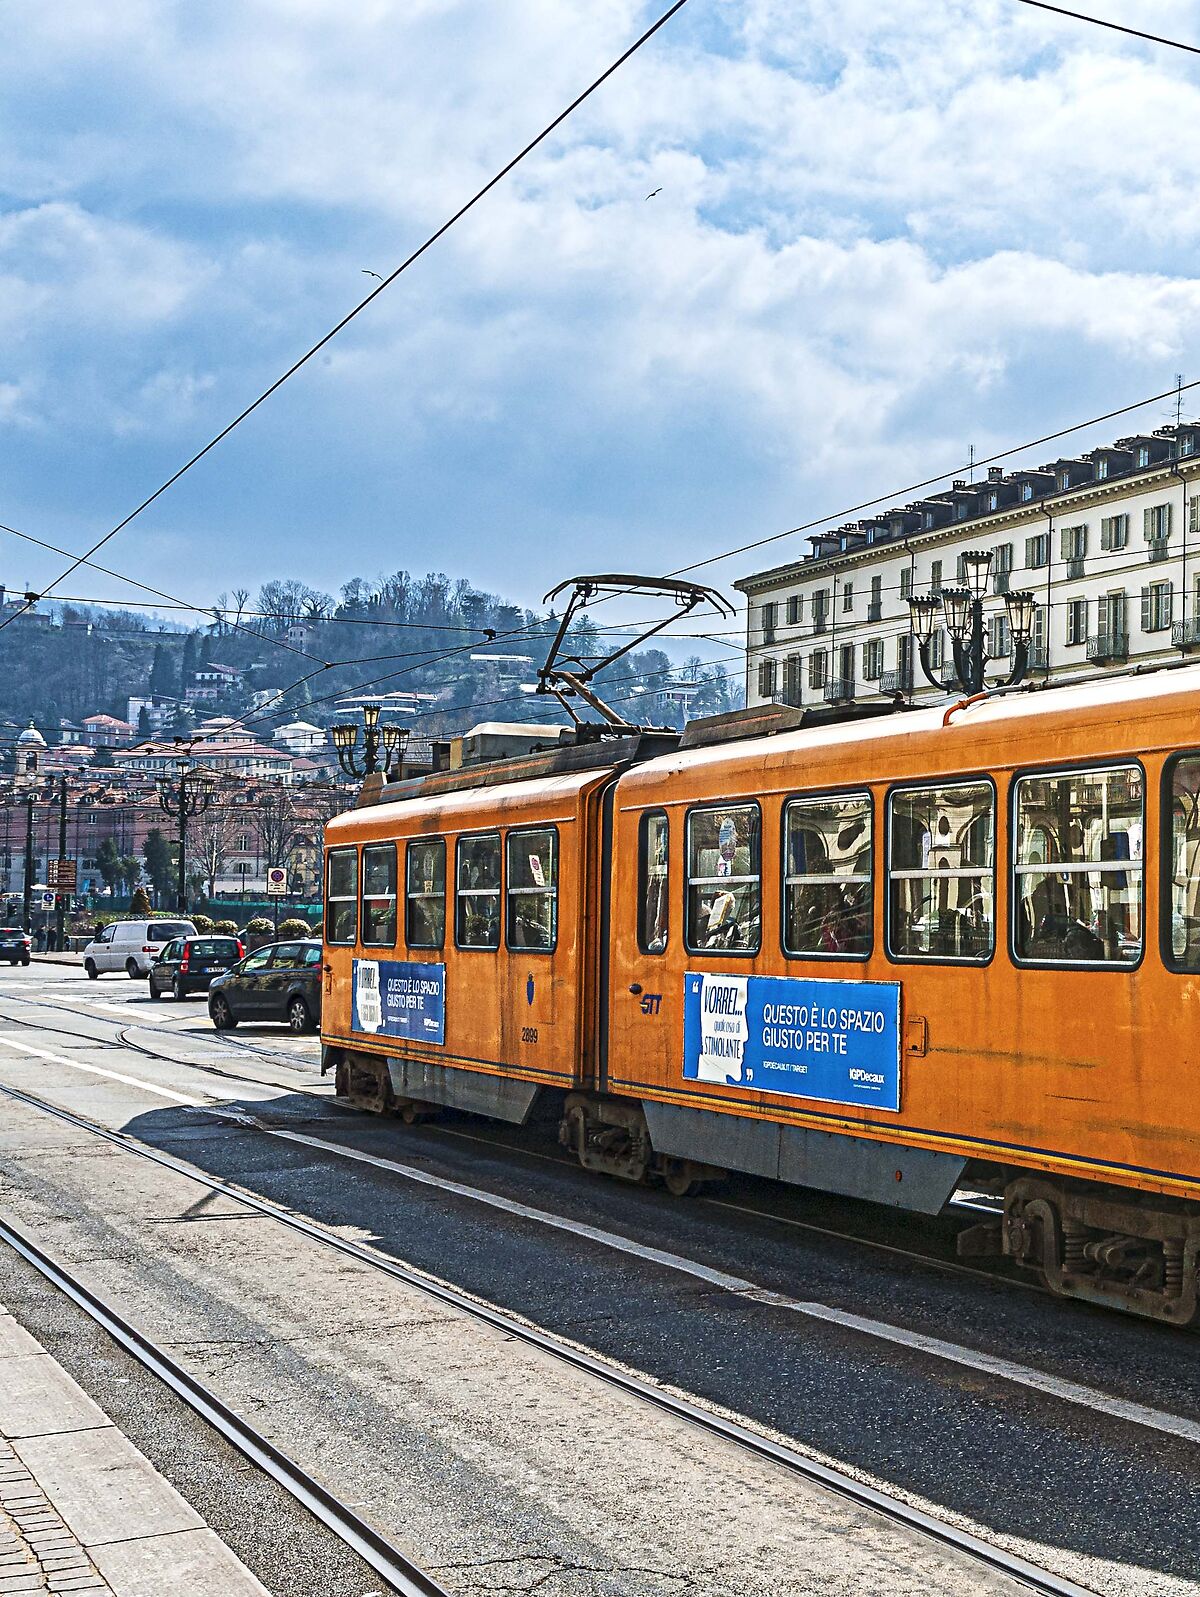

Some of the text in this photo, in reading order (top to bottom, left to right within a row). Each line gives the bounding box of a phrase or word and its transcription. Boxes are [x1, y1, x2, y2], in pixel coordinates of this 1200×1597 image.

[387, 978, 407, 993] QUESTO
[412, 979, 420, 994] LO
[420, 980, 440, 996] SPAZIO
[387, 994, 406, 1008] GIUSTO
[406, 996, 417, 1009] PER
[416, 996, 424, 1010] TE
[763, 1001, 885, 1034] QUESTO È LO SPAZIO
[522, 1027, 538, 1043] 2899
[762, 1026, 848, 1055] GIUSTO PER TE
[704, 1036, 741, 1060] STIMOLANTE
[849, 1067, 885, 1084] IGPDecaux
